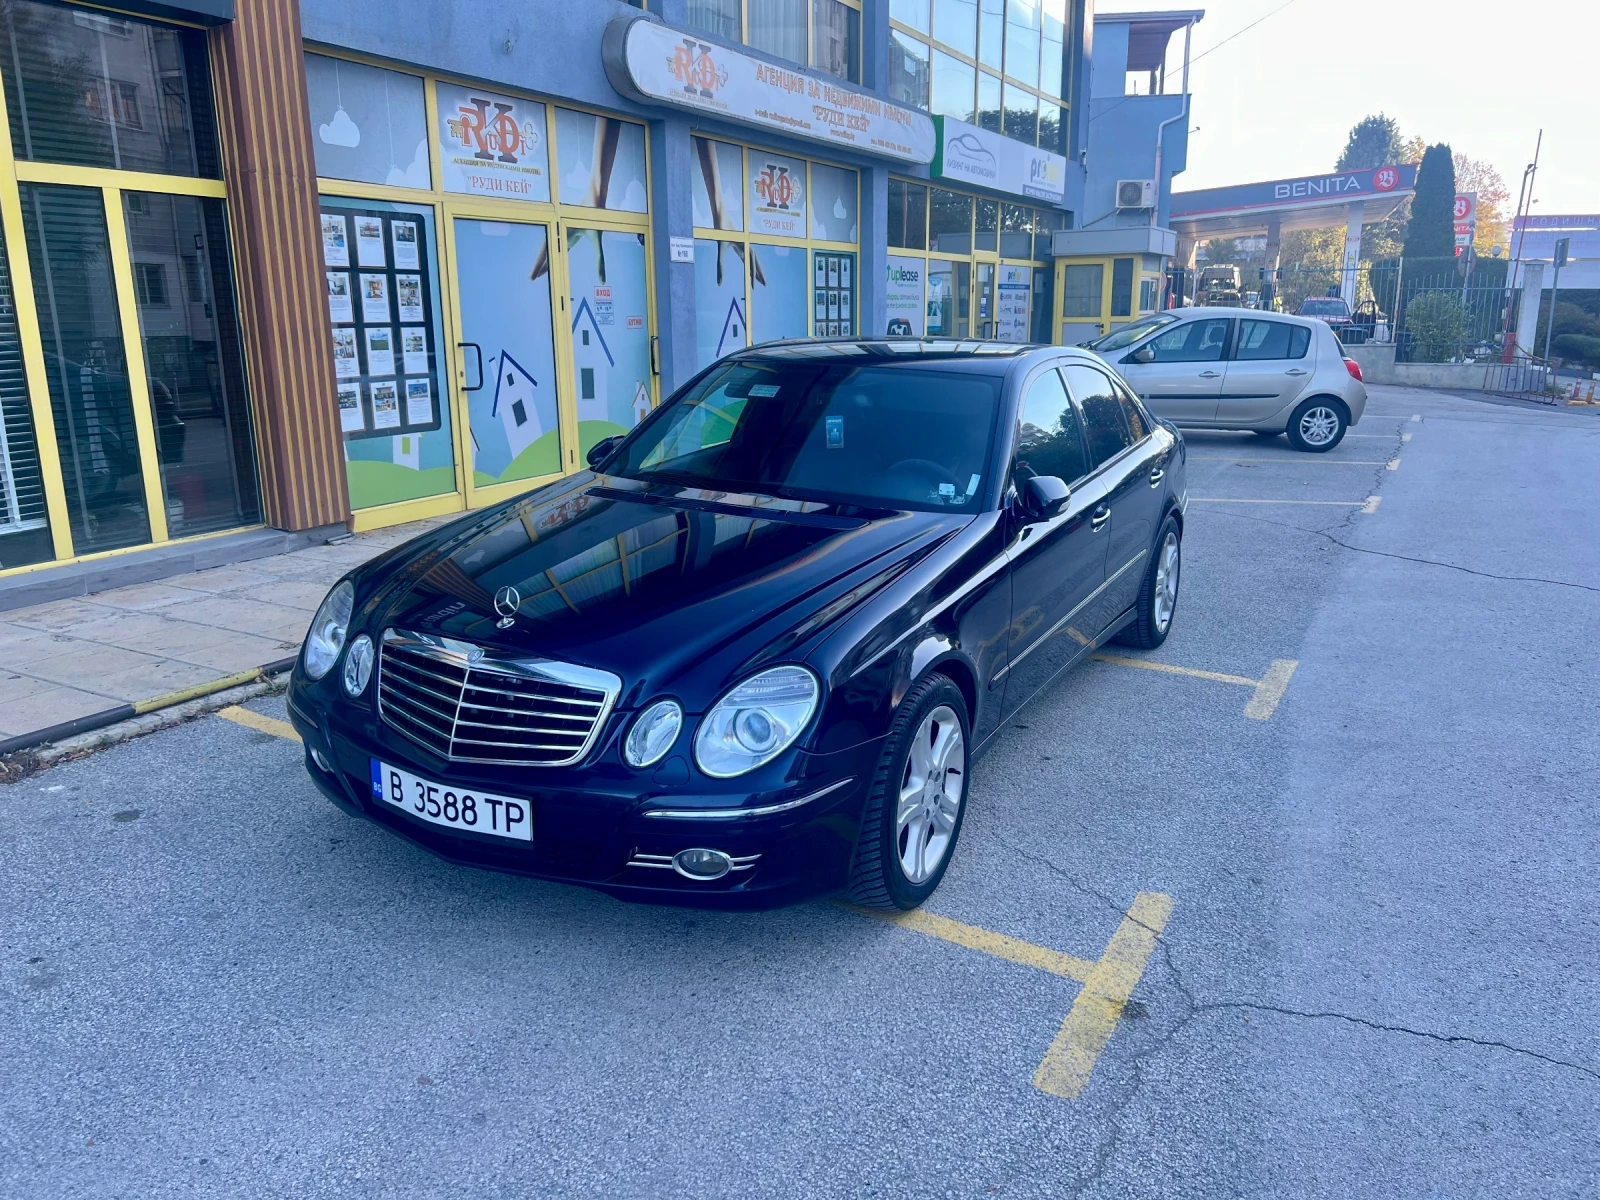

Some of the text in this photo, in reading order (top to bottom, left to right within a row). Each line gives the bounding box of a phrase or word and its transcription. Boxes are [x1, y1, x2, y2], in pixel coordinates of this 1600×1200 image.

[756, 64, 804, 94] АГЕНЦИЯ
[808, 82, 821, 99] ЗА
[824, 86, 881, 116] НЕДВИЖИМИ
[467, 176, 504, 192] "РУДИ
[1275, 176, 1361, 199] BENITA
[1531, 216, 1600, 226] ГОДИШН
[596, 289, 611, 298] ВХОД
[373, 781, 382, 793] BG
[390, 770, 525, 833] B 3588 TP
